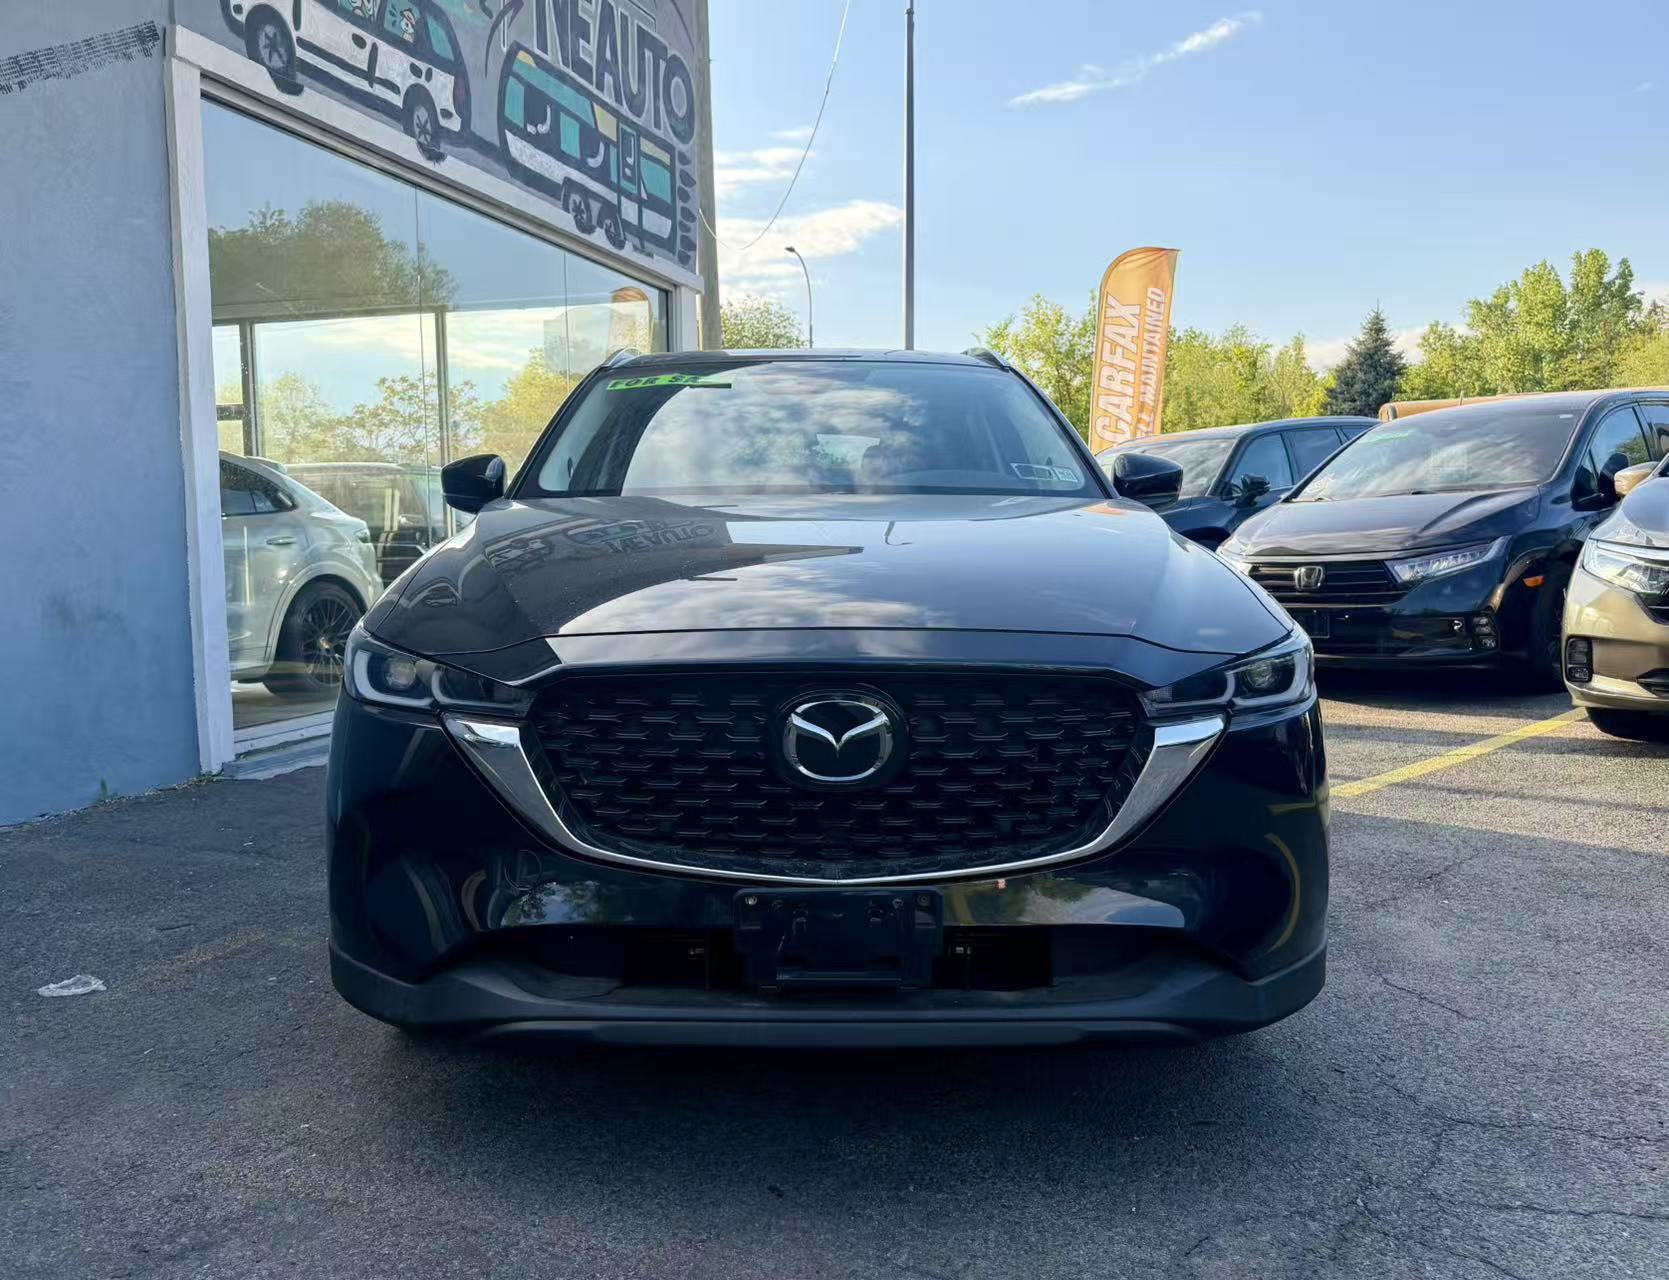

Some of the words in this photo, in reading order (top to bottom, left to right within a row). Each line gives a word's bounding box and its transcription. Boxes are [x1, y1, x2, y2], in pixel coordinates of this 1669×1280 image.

[609, 377, 658, 389] FOR
[1095, 291, 1141, 442] CARFAX
[1139, 287, 1166, 405] MAINTAINED
